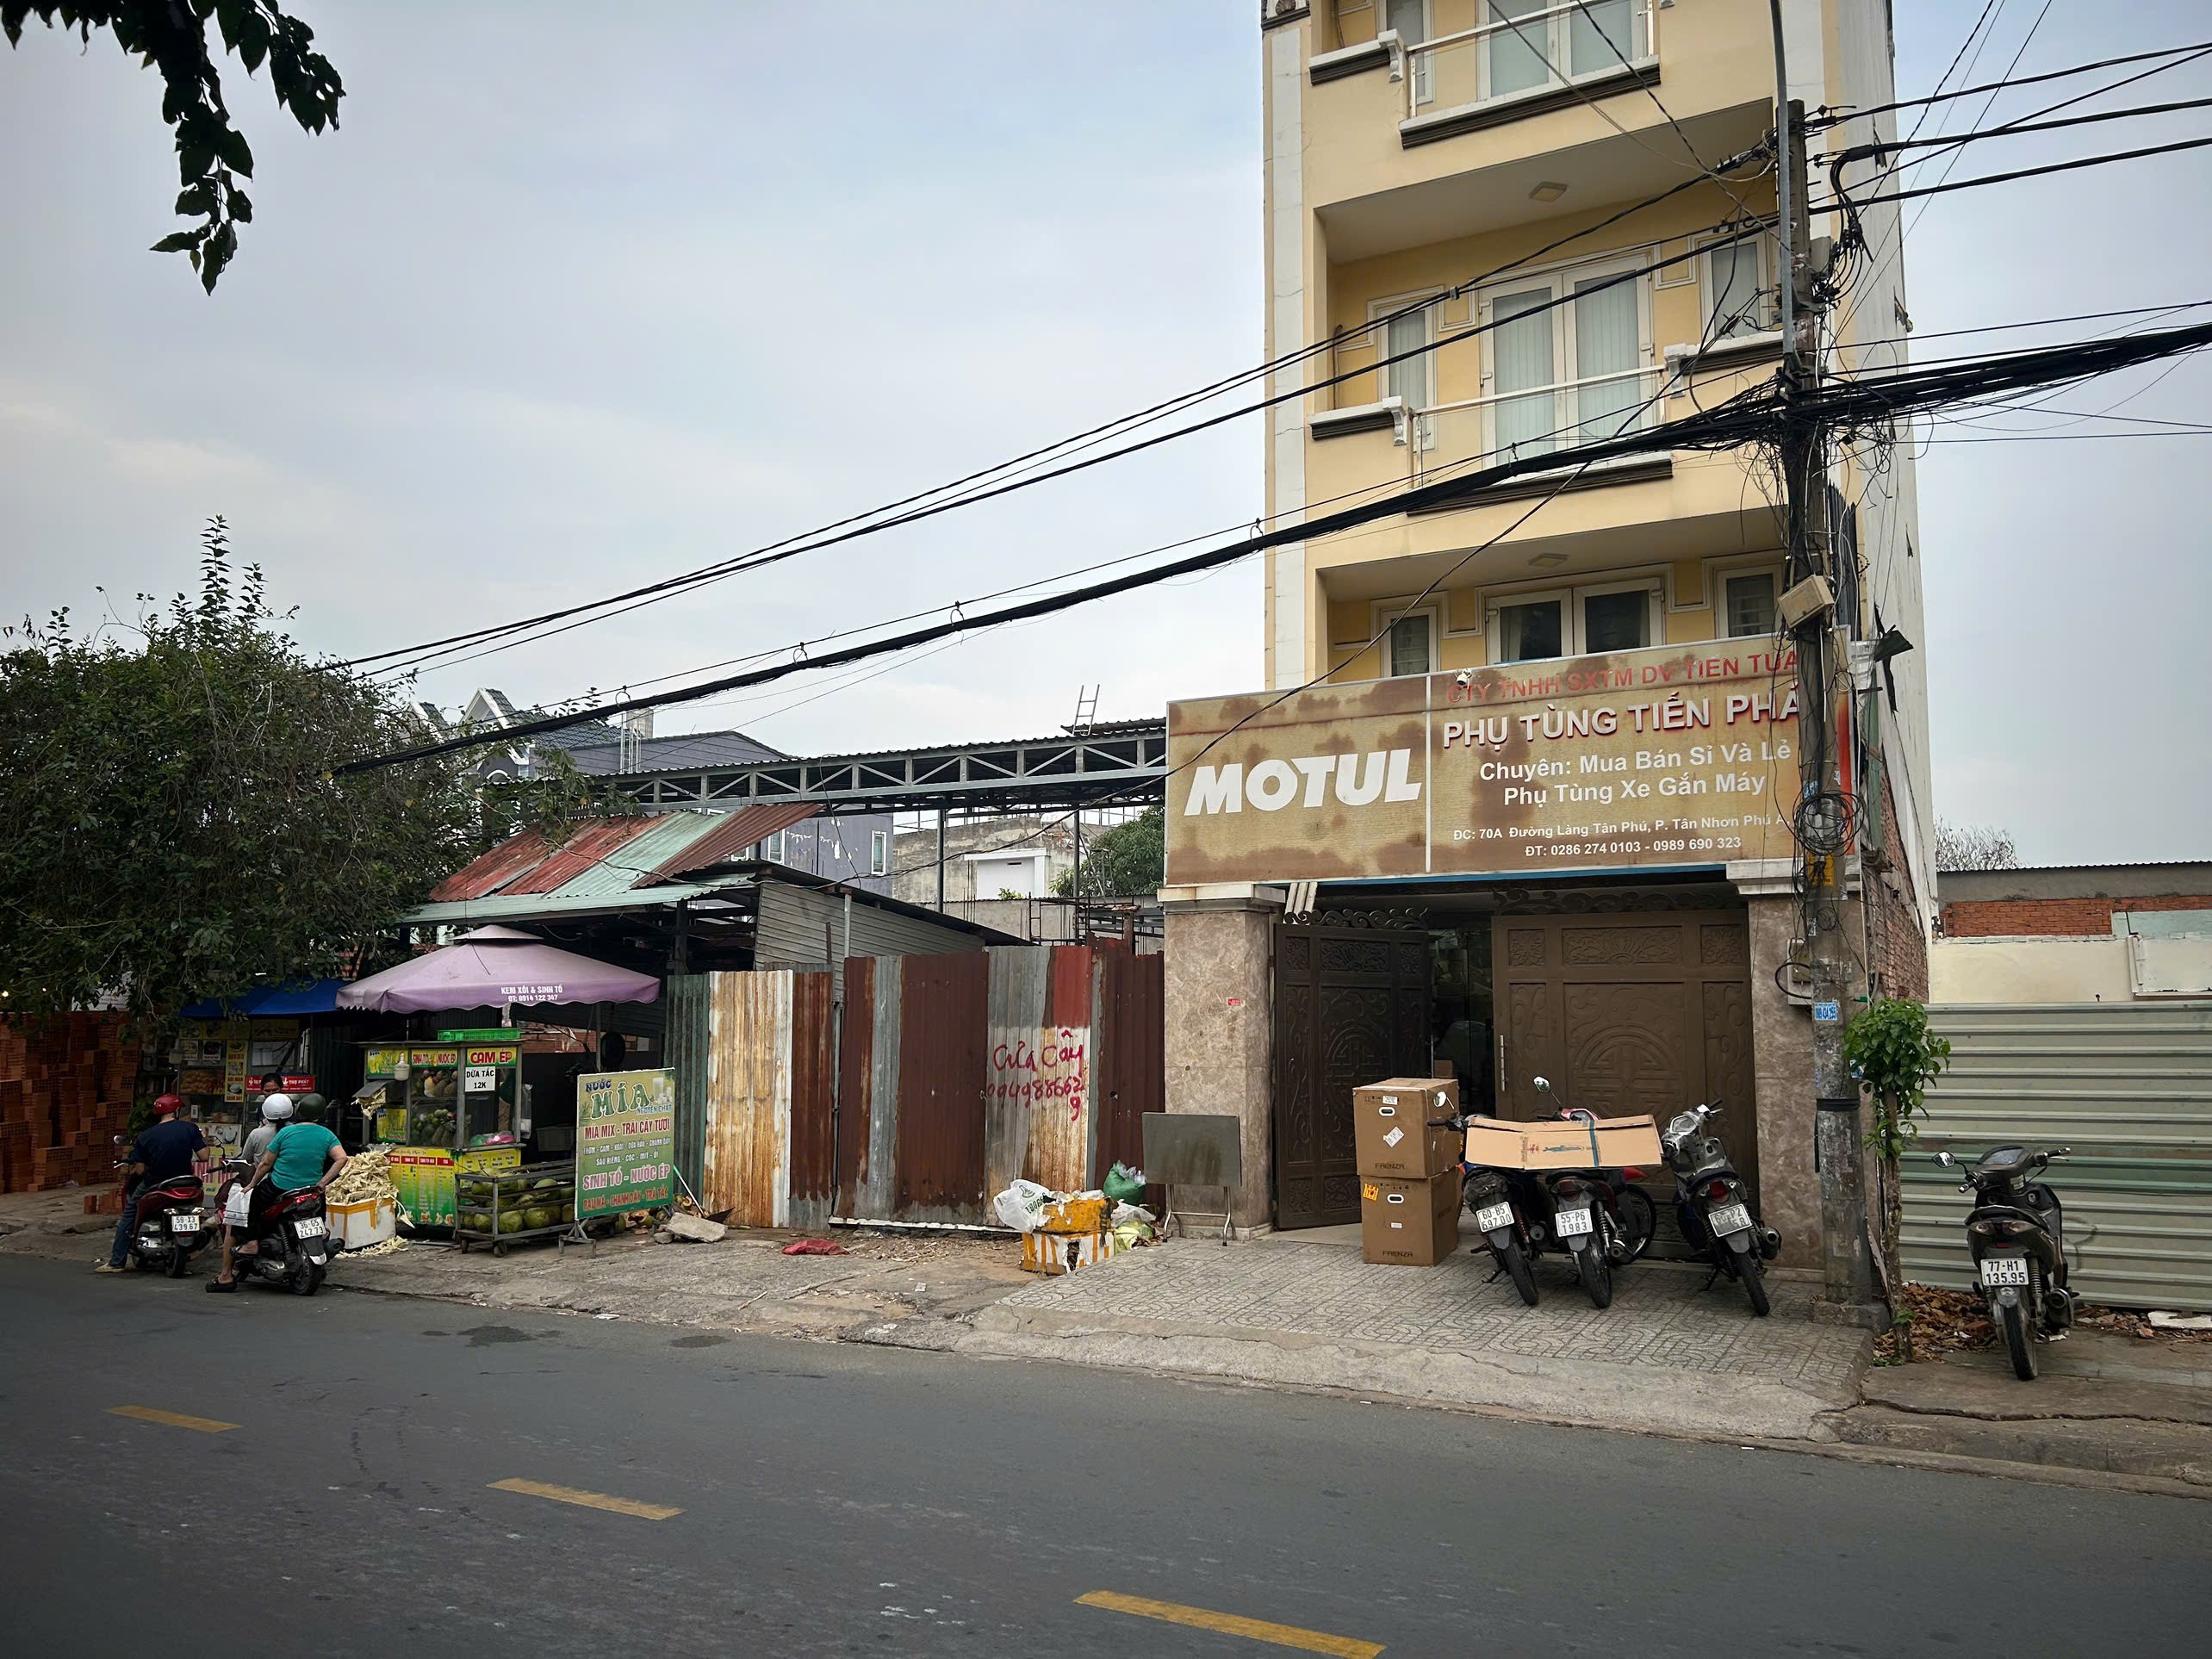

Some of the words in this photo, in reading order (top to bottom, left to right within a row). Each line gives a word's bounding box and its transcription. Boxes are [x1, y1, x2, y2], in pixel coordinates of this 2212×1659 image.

[1501, 675, 1560, 698] TNHH
[1568, 667, 1632, 692] SXTM
[1643, 664, 1675, 684] DV
[1748, 650, 1798, 674] TUA
[1443, 717, 1507, 751] PHỤ
[1519, 703, 1617, 742] TÙNG
[1627, 691, 1710, 731] TIẾN
[1726, 680, 1799, 724] PHÁ
[1479, 758, 1572, 783] Chuyên:
[1580, 754, 1627, 774] Mua
[1636, 746, 1681, 770] Bán
[1689, 745, 1712, 765] Sỉ
[1720, 743, 1752, 762] Và
[1762, 739, 1792, 760] Lẻ
[1184, 749, 1421, 816] MOTUL
[1504, 784, 1546, 806] Phụ
[1554, 781, 1612, 805] Tùng
[1620, 779, 1650, 799] Xe
[1659, 774, 1707, 798] Gắn
[1715, 772, 1765, 795] Máy
[1453, 829, 1476, 841] ĐC:
[1479, 827, 1502, 840] 70A
[1509, 824, 1553, 842] Đường
[1557, 822, 1588, 840] Làng
[1593, 820, 1619, 835] Tân
[1621, 818, 1650, 835] Phú,
[1655, 819, 1668, 831] P.
[1701, 817, 1739, 828] Nhơn
[1743, 814, 1771, 825] Phú
[1525, 846, 1548, 857] ĐT:
[1550, 843, 1582, 856] 0286
[1584, 842, 1607, 854] 274
[1610, 841, 1641, 854] 0103
[1653, 839, 1687, 852] 0989
[1689, 838, 1712, 850] 690
[1717, 836, 1742, 848] 323
[469, 1052, 496, 1064] CAM
[499, 1048, 513, 1064] ÉP
[586, 1078, 612, 1092] NƯỚC
[590, 1082, 650, 1120] MÍA
[585, 1123, 600, 1139] MÍA
[601, 1123, 615, 1137] MIX
[622, 1120, 638, 1134] TRÁI
[639, 1117, 653, 1134] CÂY
[655, 1116, 670, 1131] TƯƠI
[582, 1172, 607, 1190] SINH
[609, 1165, 622, 1186] TỐ
[631, 1165, 656, 1184] NƯỚC
[658, 1162, 670, 1179] ÉP
[174, 1222, 198, 1231] 439.67
[1561, 1211, 1586, 1223] 55-P6
[1562, 1221, 1588, 1234] 1983
[299, 1225, 324, 1238] 242.73
[1988, 1260, 2019, 1271] 77-H1
[1986, 1271, 2026, 1284] 135.95
